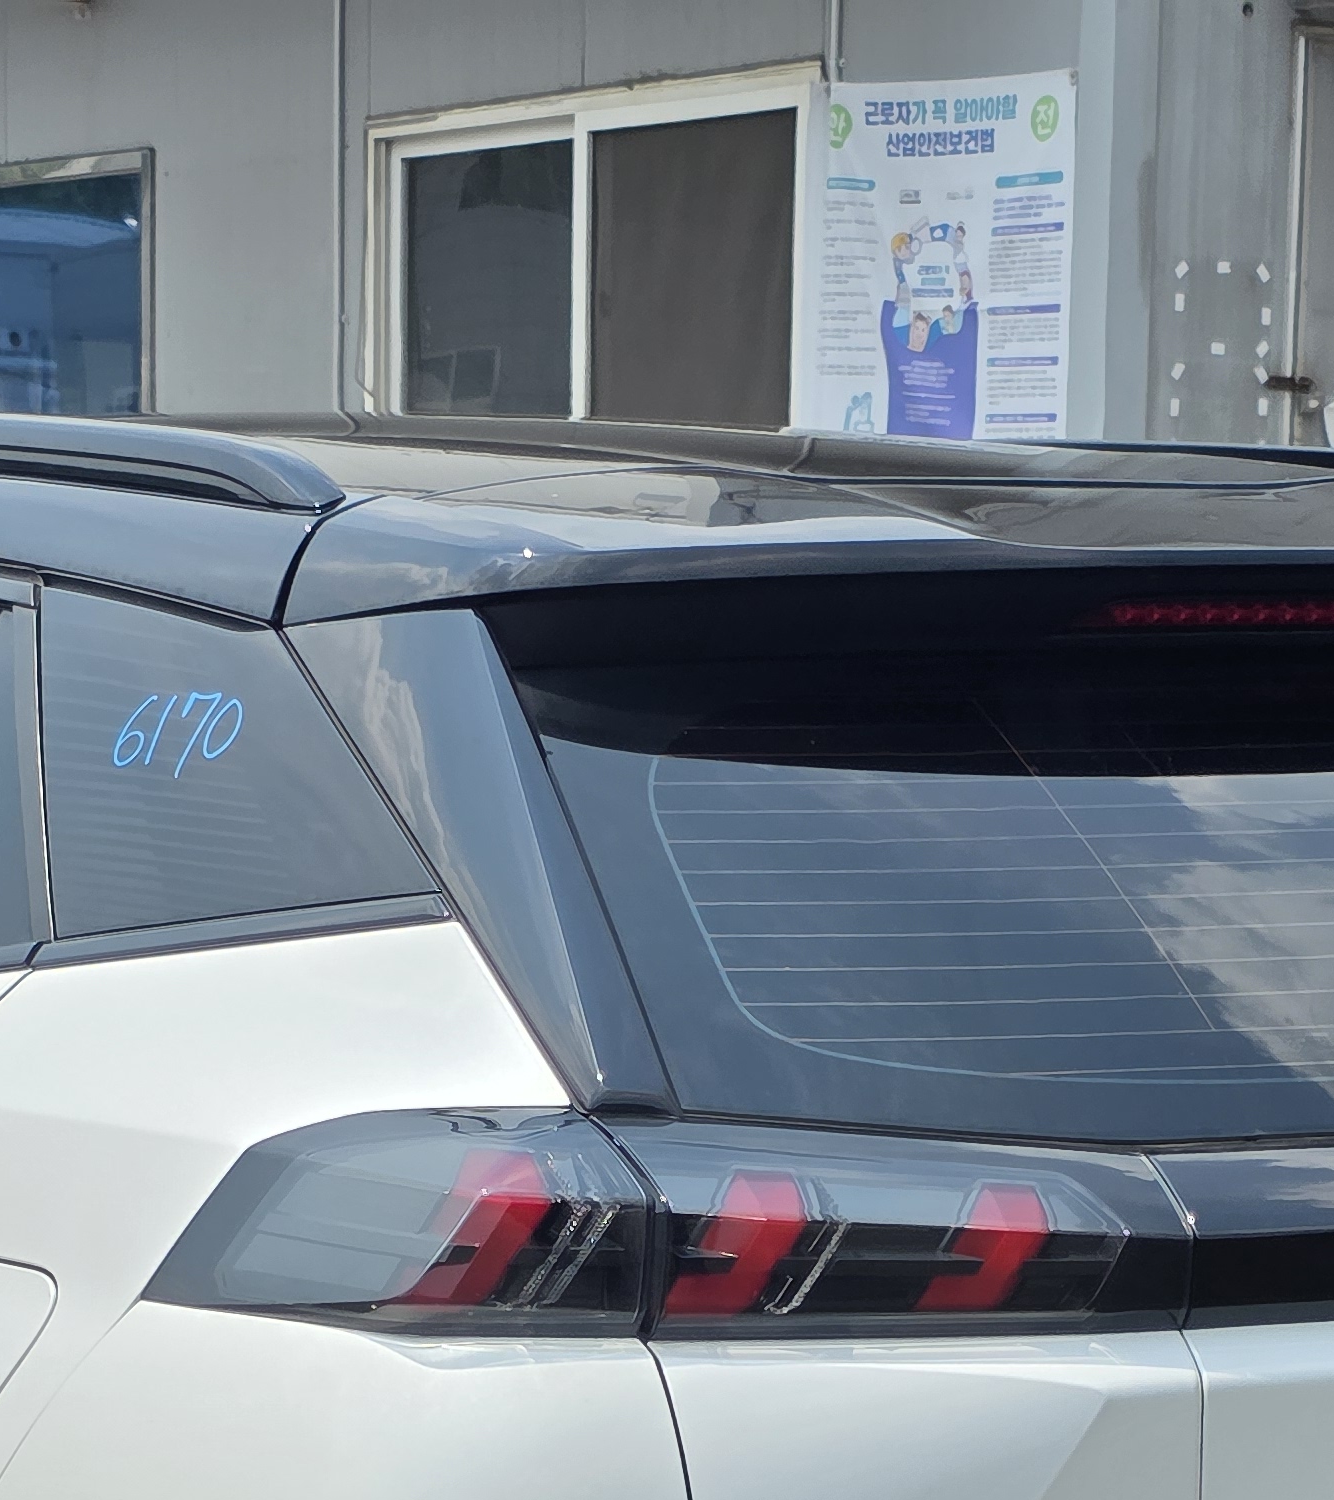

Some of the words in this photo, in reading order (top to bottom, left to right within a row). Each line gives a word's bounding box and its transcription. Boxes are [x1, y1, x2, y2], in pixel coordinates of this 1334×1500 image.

[864, 99, 927, 126] 근로자가
[953, 93, 1018, 125] 알아야할
[886, 127, 996, 158] 산업안전보건법
[113, 691, 243, 779] 6170
